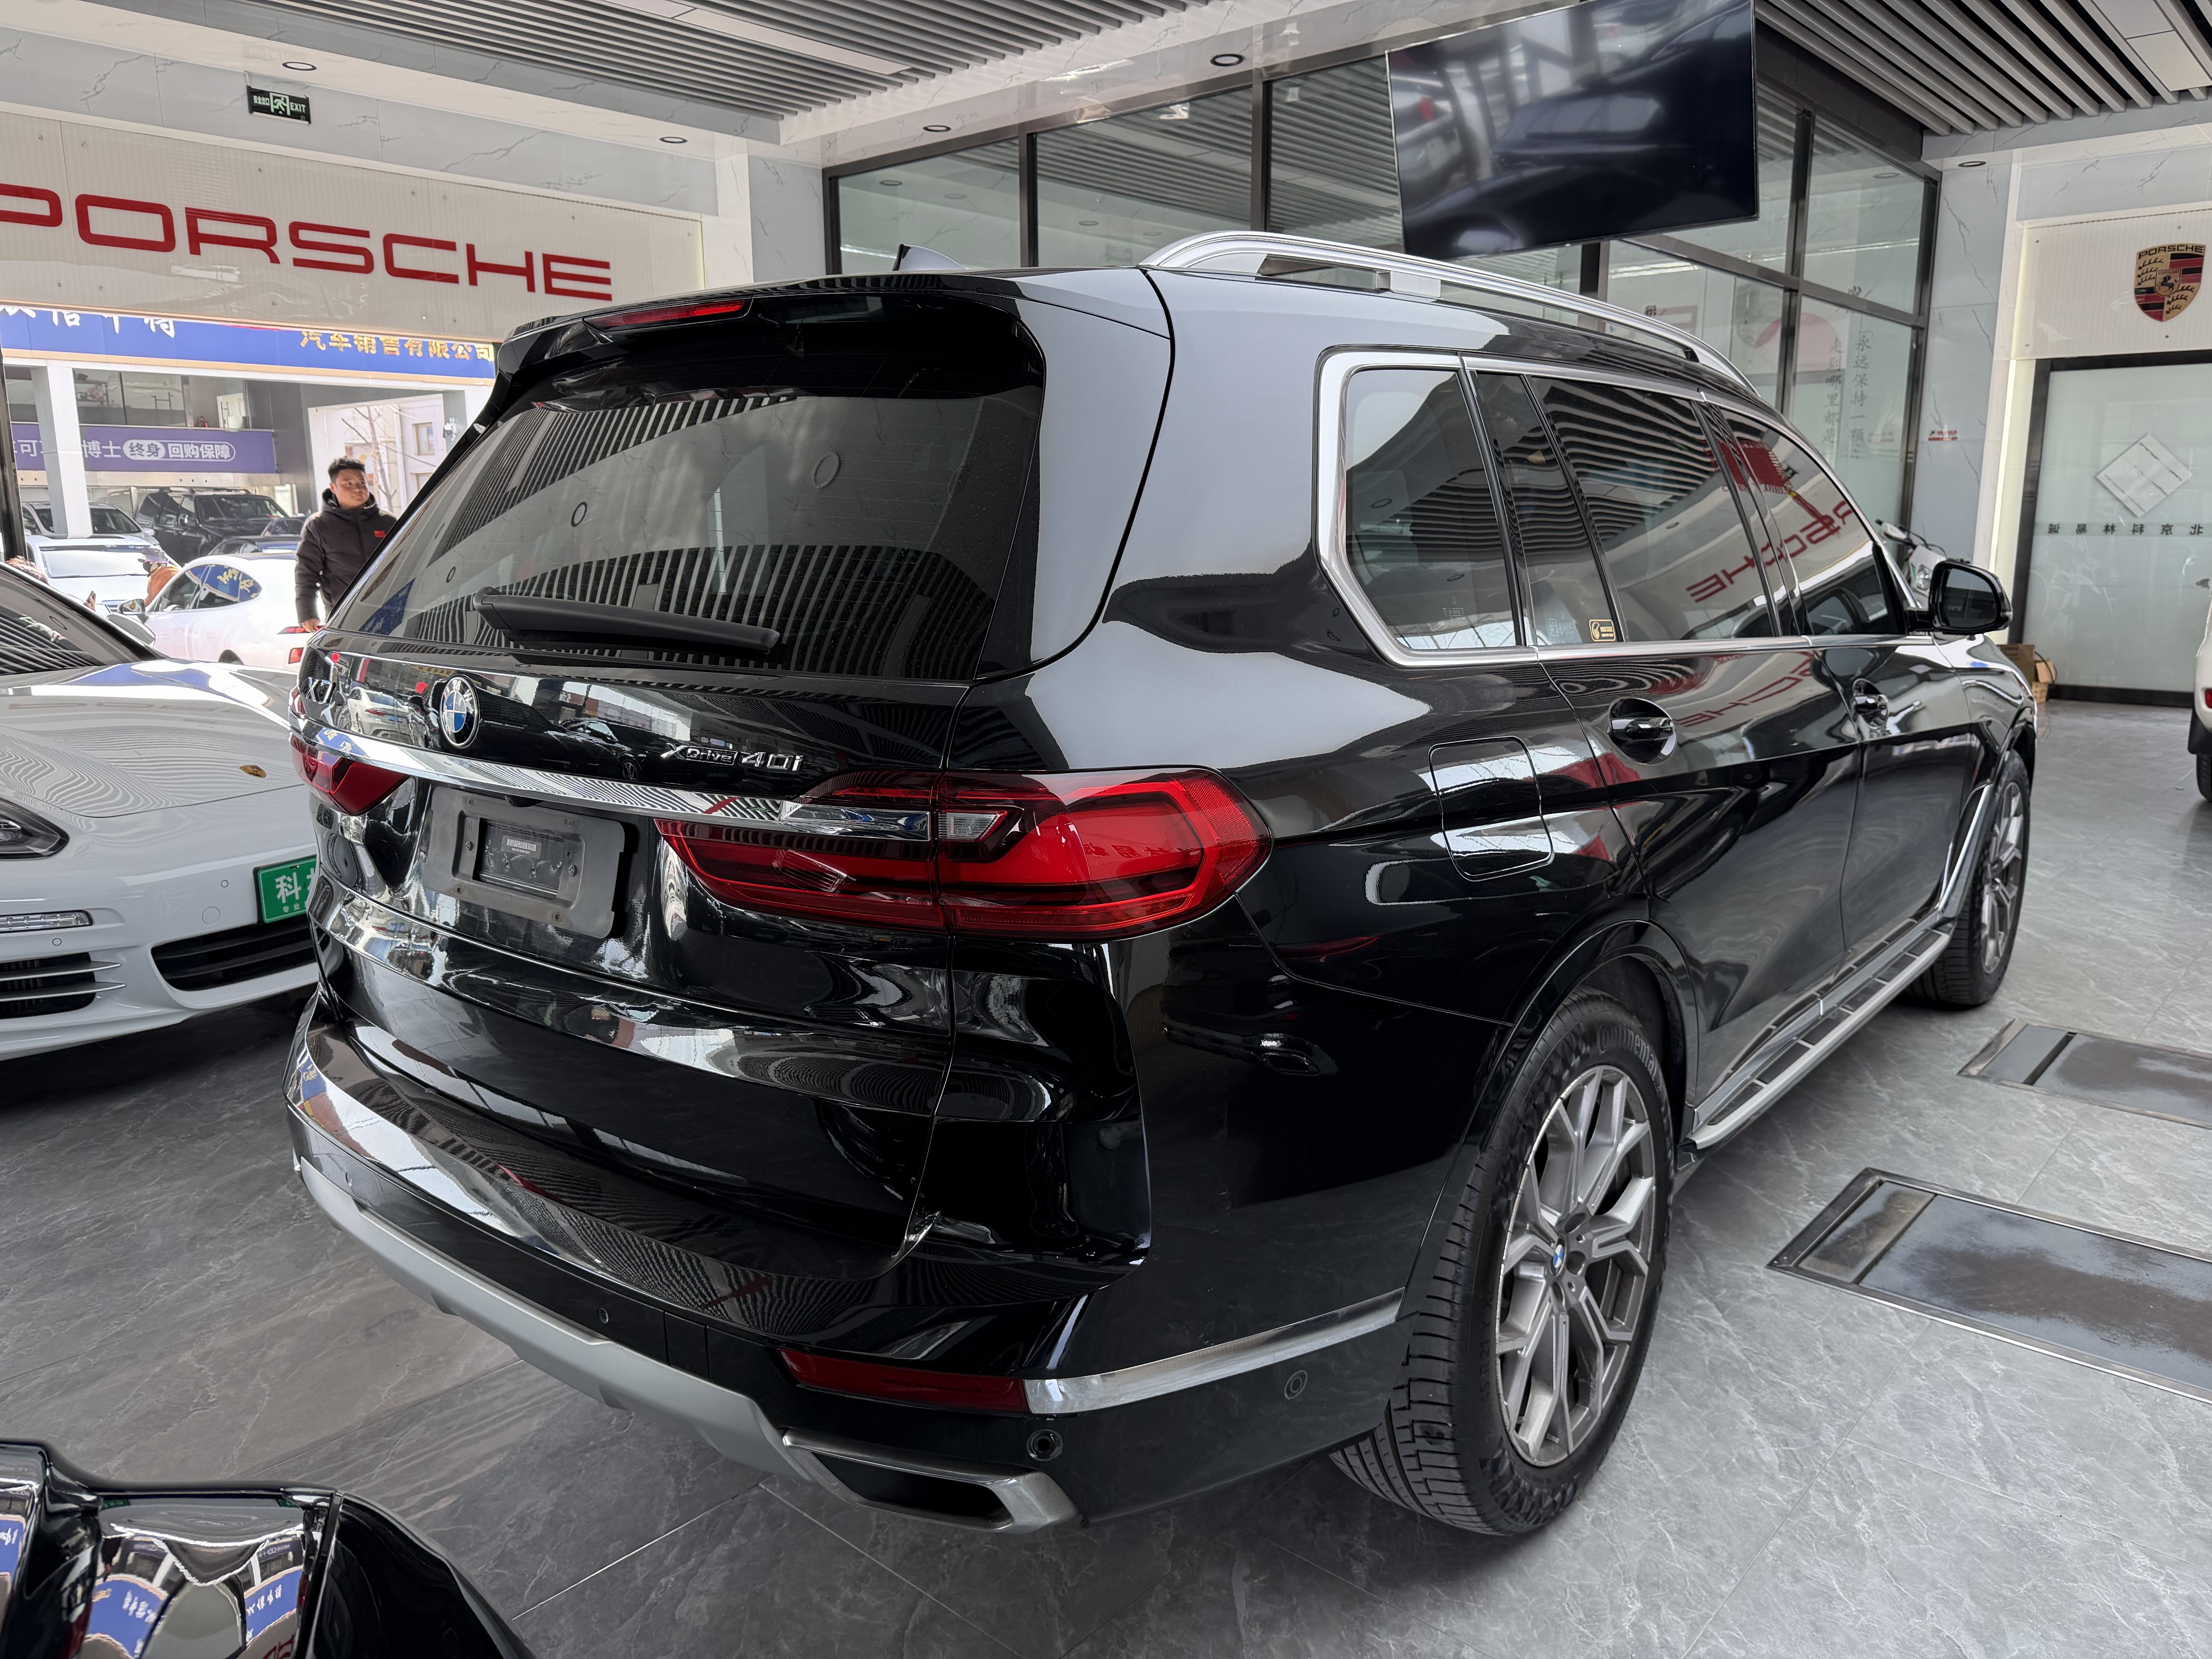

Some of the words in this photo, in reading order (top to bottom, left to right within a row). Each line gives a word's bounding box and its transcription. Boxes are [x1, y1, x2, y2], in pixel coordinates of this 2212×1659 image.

[253, 95, 270, 106] 安全出口
[290, 102, 306, 113] EXIT
[2138, 244, 2203, 259] PORSCHE
[300, 331, 495, 362] 汽车销售有限公司
[129, 442, 160, 457] 终身
[168, 443, 230, 459] 回购保障
[444, 679, 473, 702] BMW
[742, 752, 805, 771] 40i
